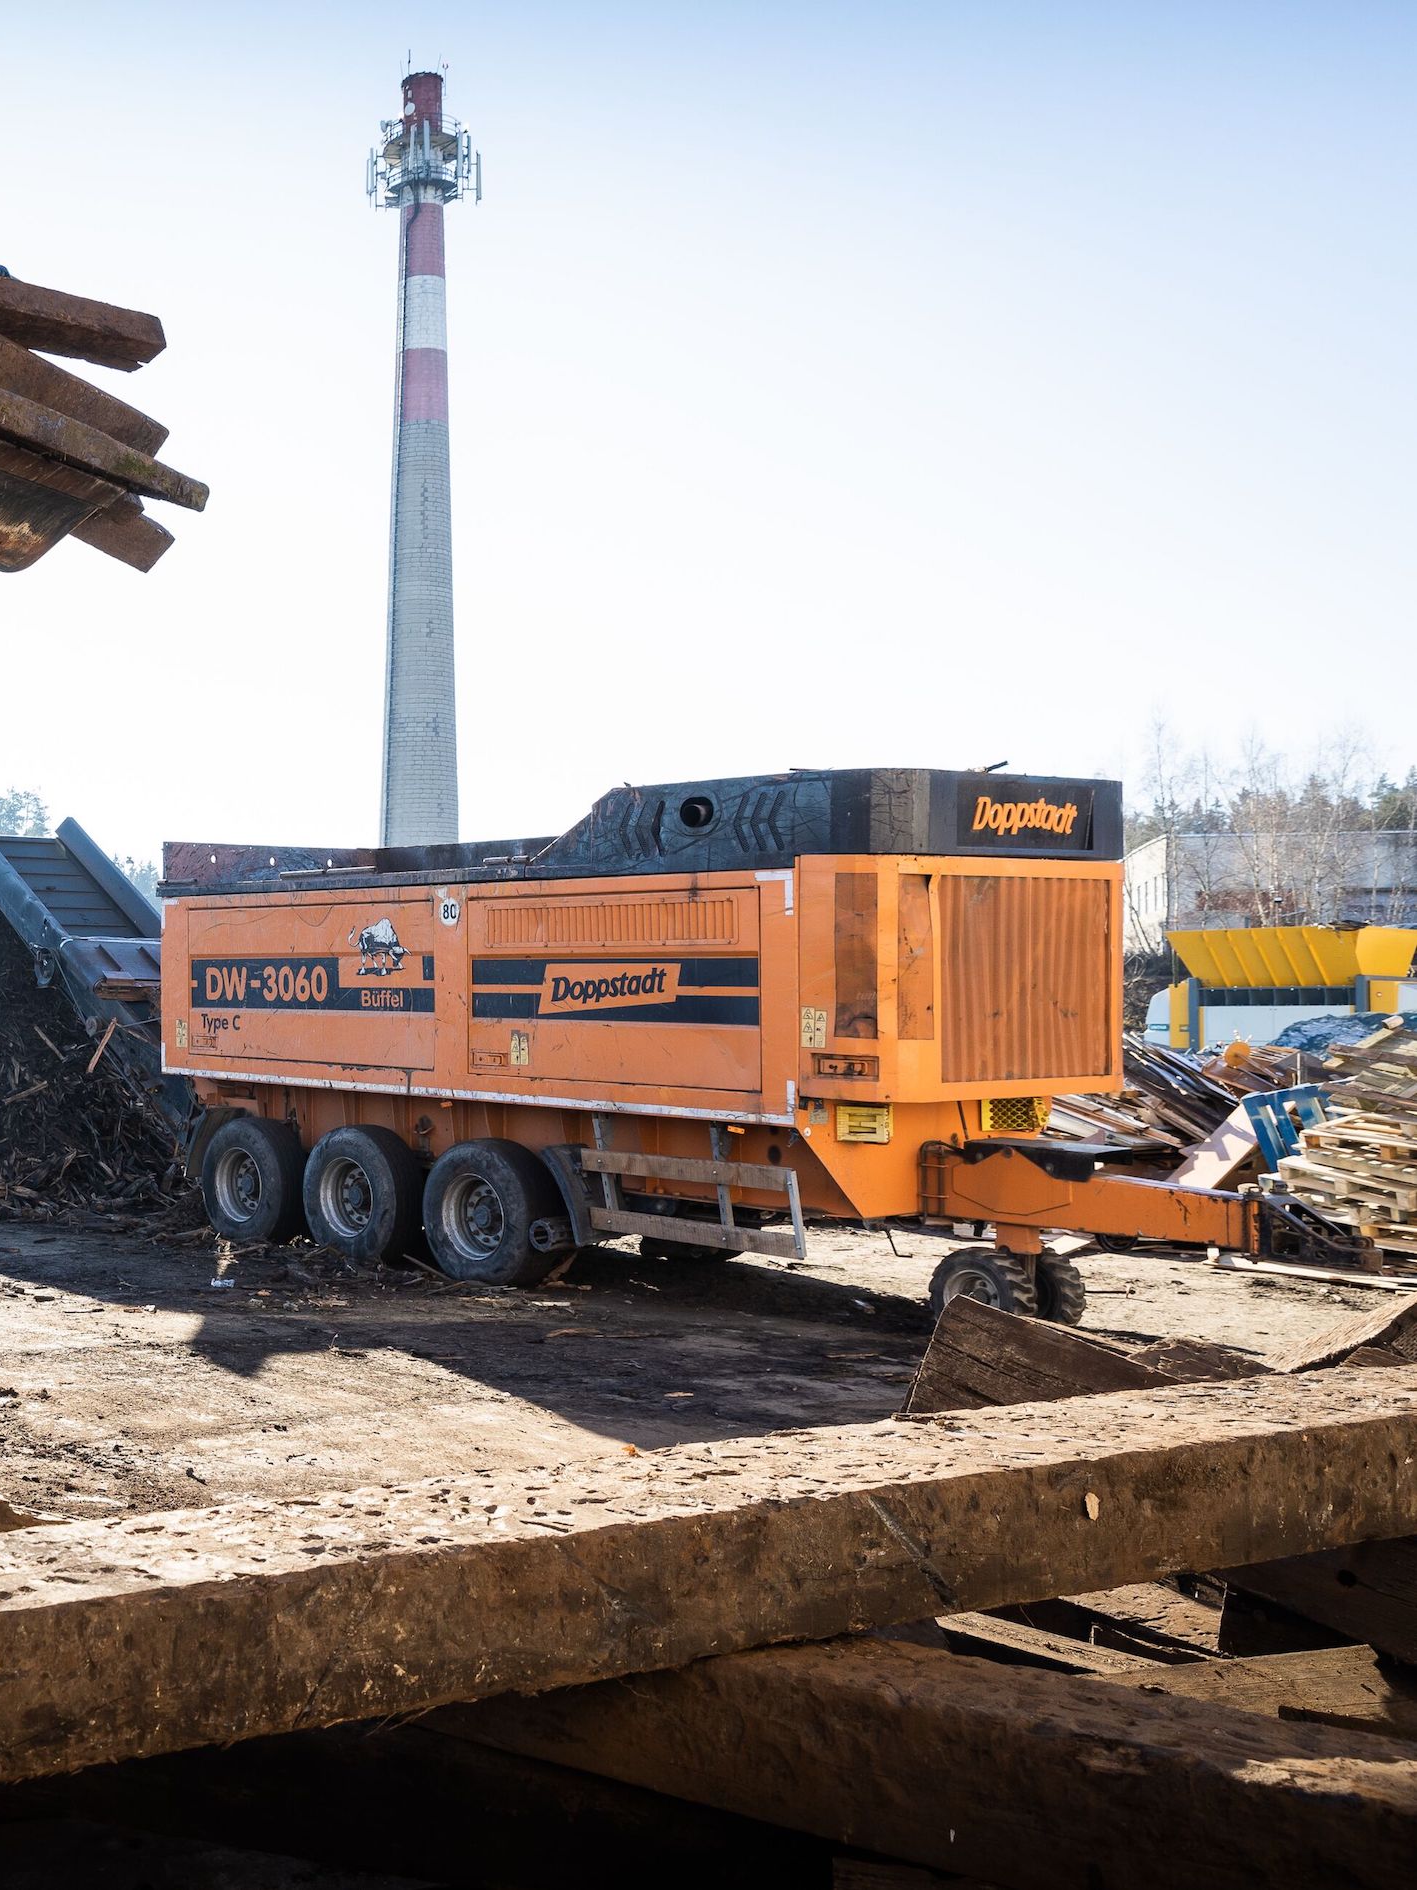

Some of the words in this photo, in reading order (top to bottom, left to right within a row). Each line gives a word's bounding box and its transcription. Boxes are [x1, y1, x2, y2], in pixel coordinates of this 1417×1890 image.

[972, 796, 1078, 836] Doppstadt
[443, 903, 457, 919] 80
[205, 965, 328, 1002] DW-3060
[551, 967, 667, 1004] Doppstadt
[360, 989, 404, 1008] Büffel
[201, 1013, 230, 1033] Type
[232, 1014, 241, 1031] C
